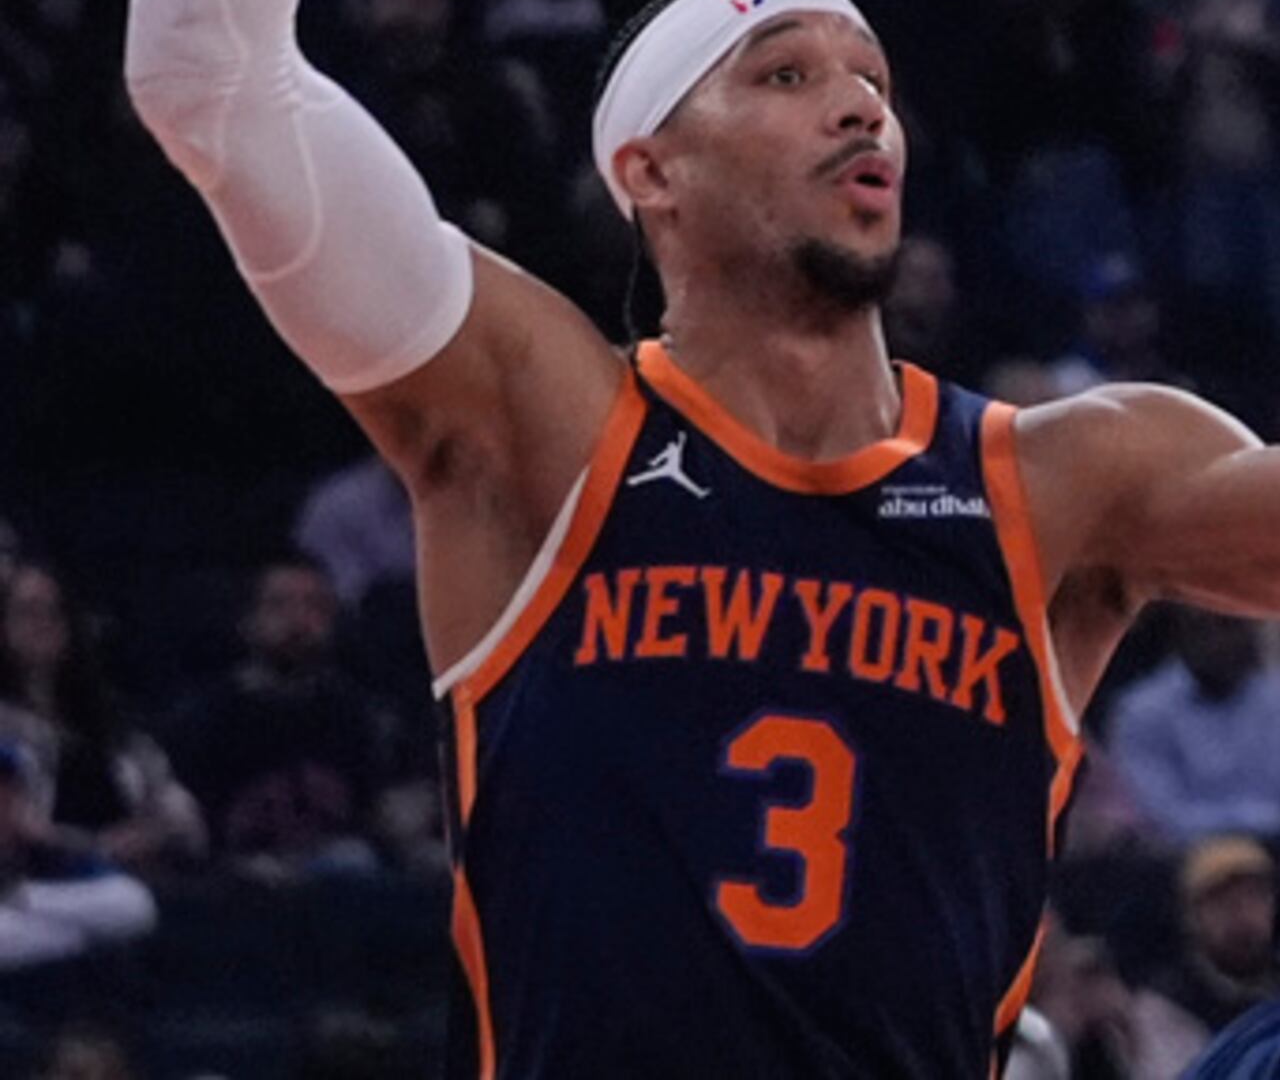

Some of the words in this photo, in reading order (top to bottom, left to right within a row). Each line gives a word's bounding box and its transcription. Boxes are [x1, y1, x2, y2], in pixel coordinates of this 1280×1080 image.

[575, 565, 784, 665] NEW
[793, 578, 1020, 725] YORK
[715, 713, 858, 951] 3
